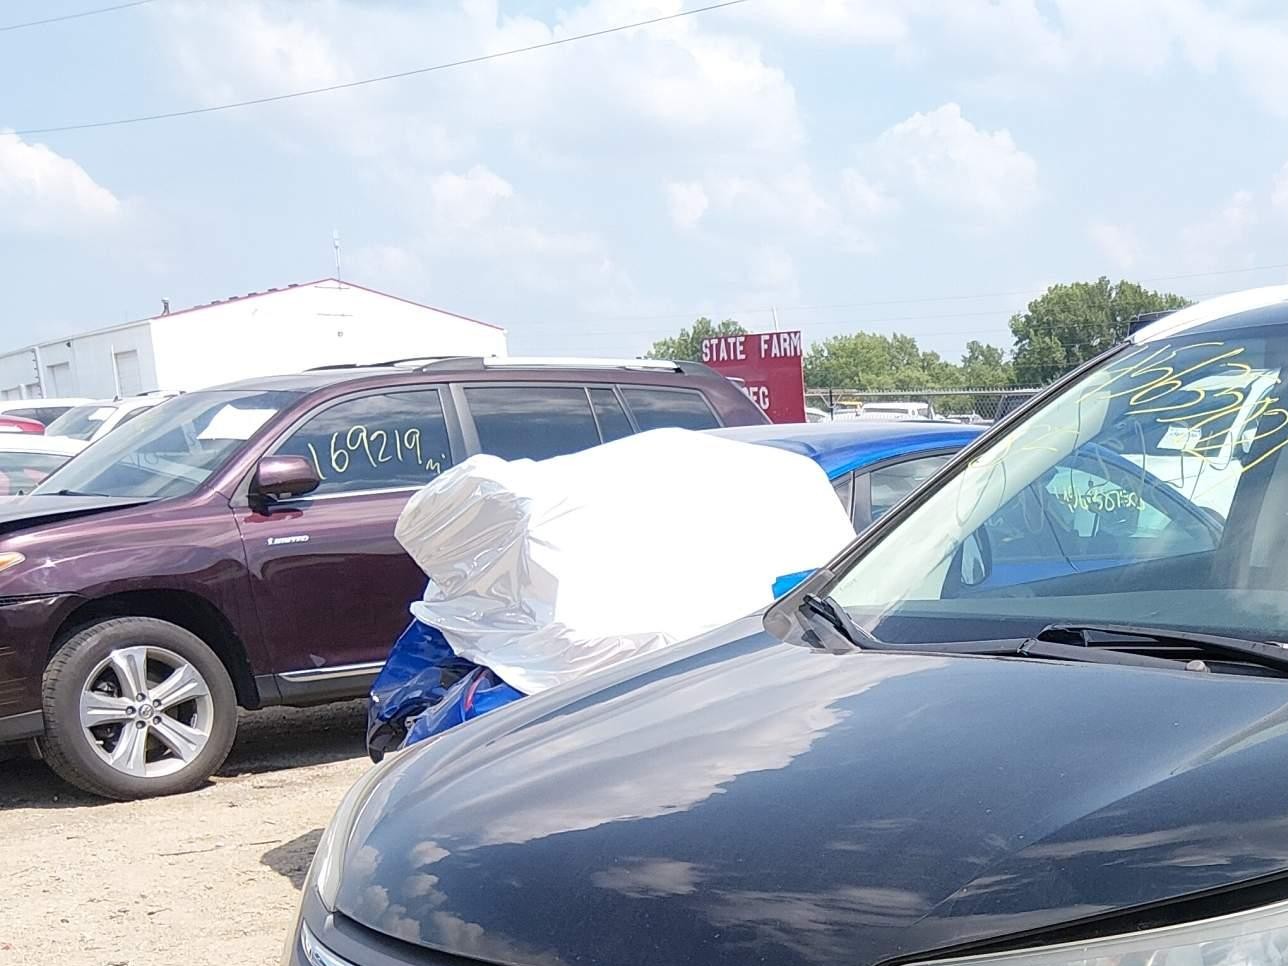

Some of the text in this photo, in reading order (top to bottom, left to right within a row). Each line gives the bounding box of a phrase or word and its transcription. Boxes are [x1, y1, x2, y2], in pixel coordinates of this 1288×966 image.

[702, 332, 801, 362] STATE FARM
[308, 425, 423, 480] 169219
